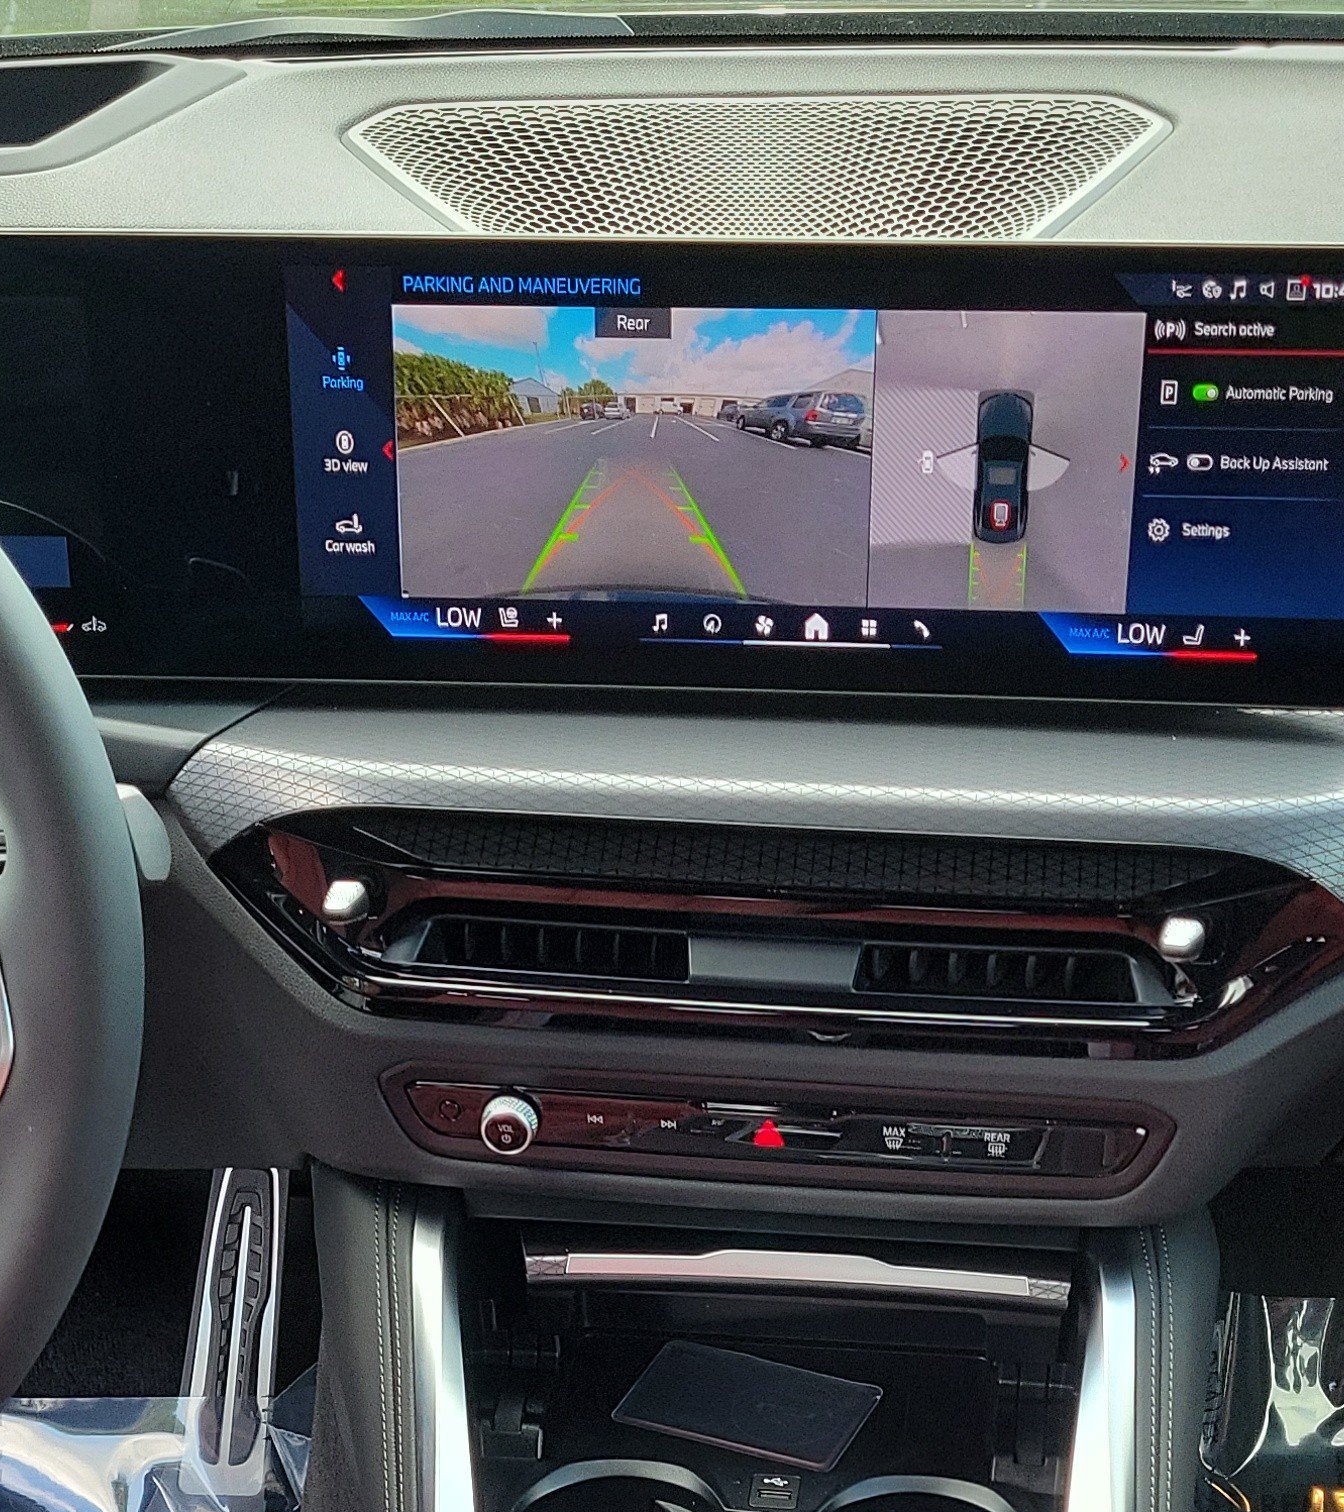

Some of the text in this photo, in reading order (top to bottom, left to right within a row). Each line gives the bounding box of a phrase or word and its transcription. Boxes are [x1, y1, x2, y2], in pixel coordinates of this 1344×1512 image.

[403, 275, 641, 296] PARKING AND MANEUVERING
[616, 315, 650, 331] Rear
[1194, 322, 1275, 337] Search active
[322, 375, 364, 393] Parking
[1226, 386, 1334, 404] Automatic Parking
[324, 458, 368, 473] 3D view
[1220, 456, 1329, 473] Back Up Assistant
[1182, 523, 1230, 540] Settings
[325, 540, 375, 554] Car wash
[390, 611, 411, 622] MAX
[436, 606, 482, 628] LOW
[1118, 622, 1166, 645] LOW
[497, 1124, 513, 1134] VOL
[883, 1126, 1010, 1143] MAX REAR
